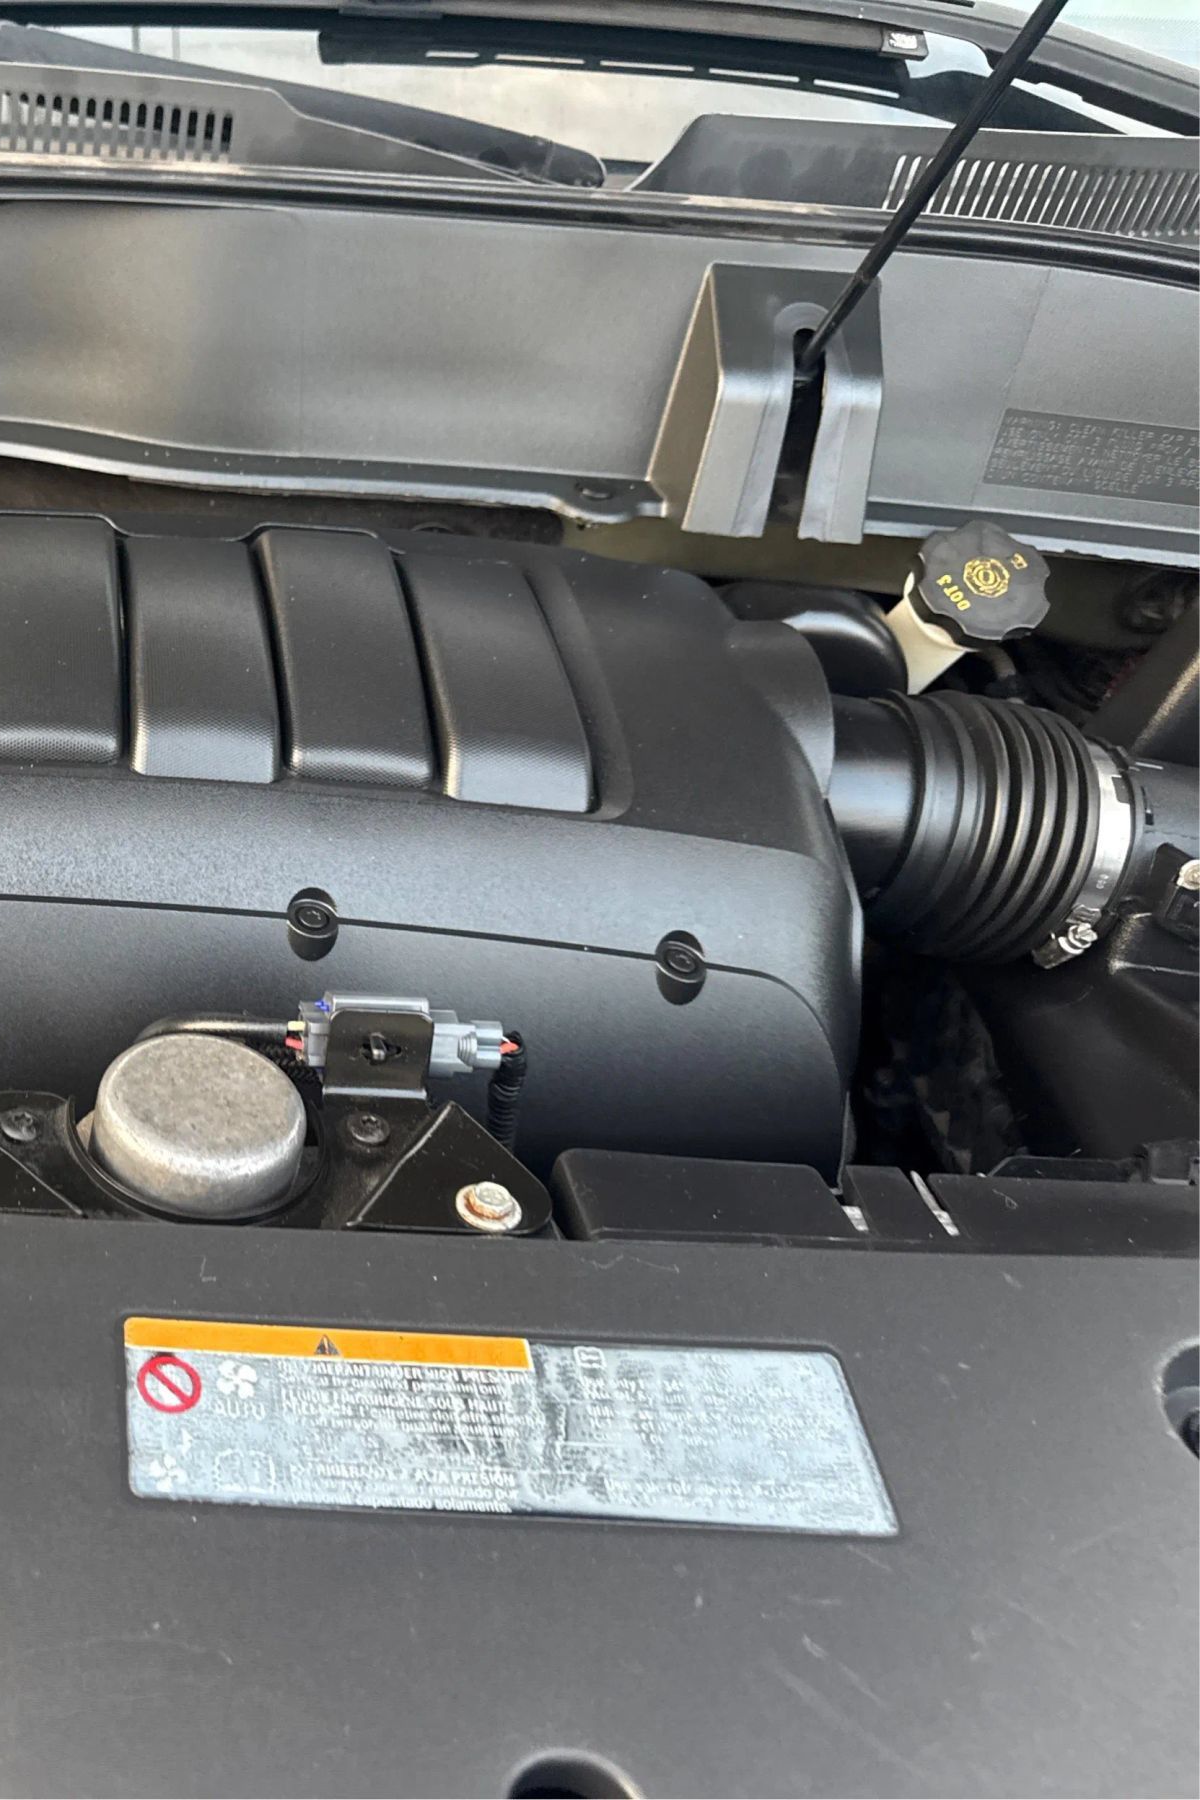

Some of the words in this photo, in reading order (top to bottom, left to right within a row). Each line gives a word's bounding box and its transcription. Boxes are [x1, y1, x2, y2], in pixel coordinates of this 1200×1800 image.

[936, 574, 953, 587] 3
[943, 585, 971, 611] DOT
[495, 1489, 520, 1502] por
[435, 1497, 513, 1513] solamente.
